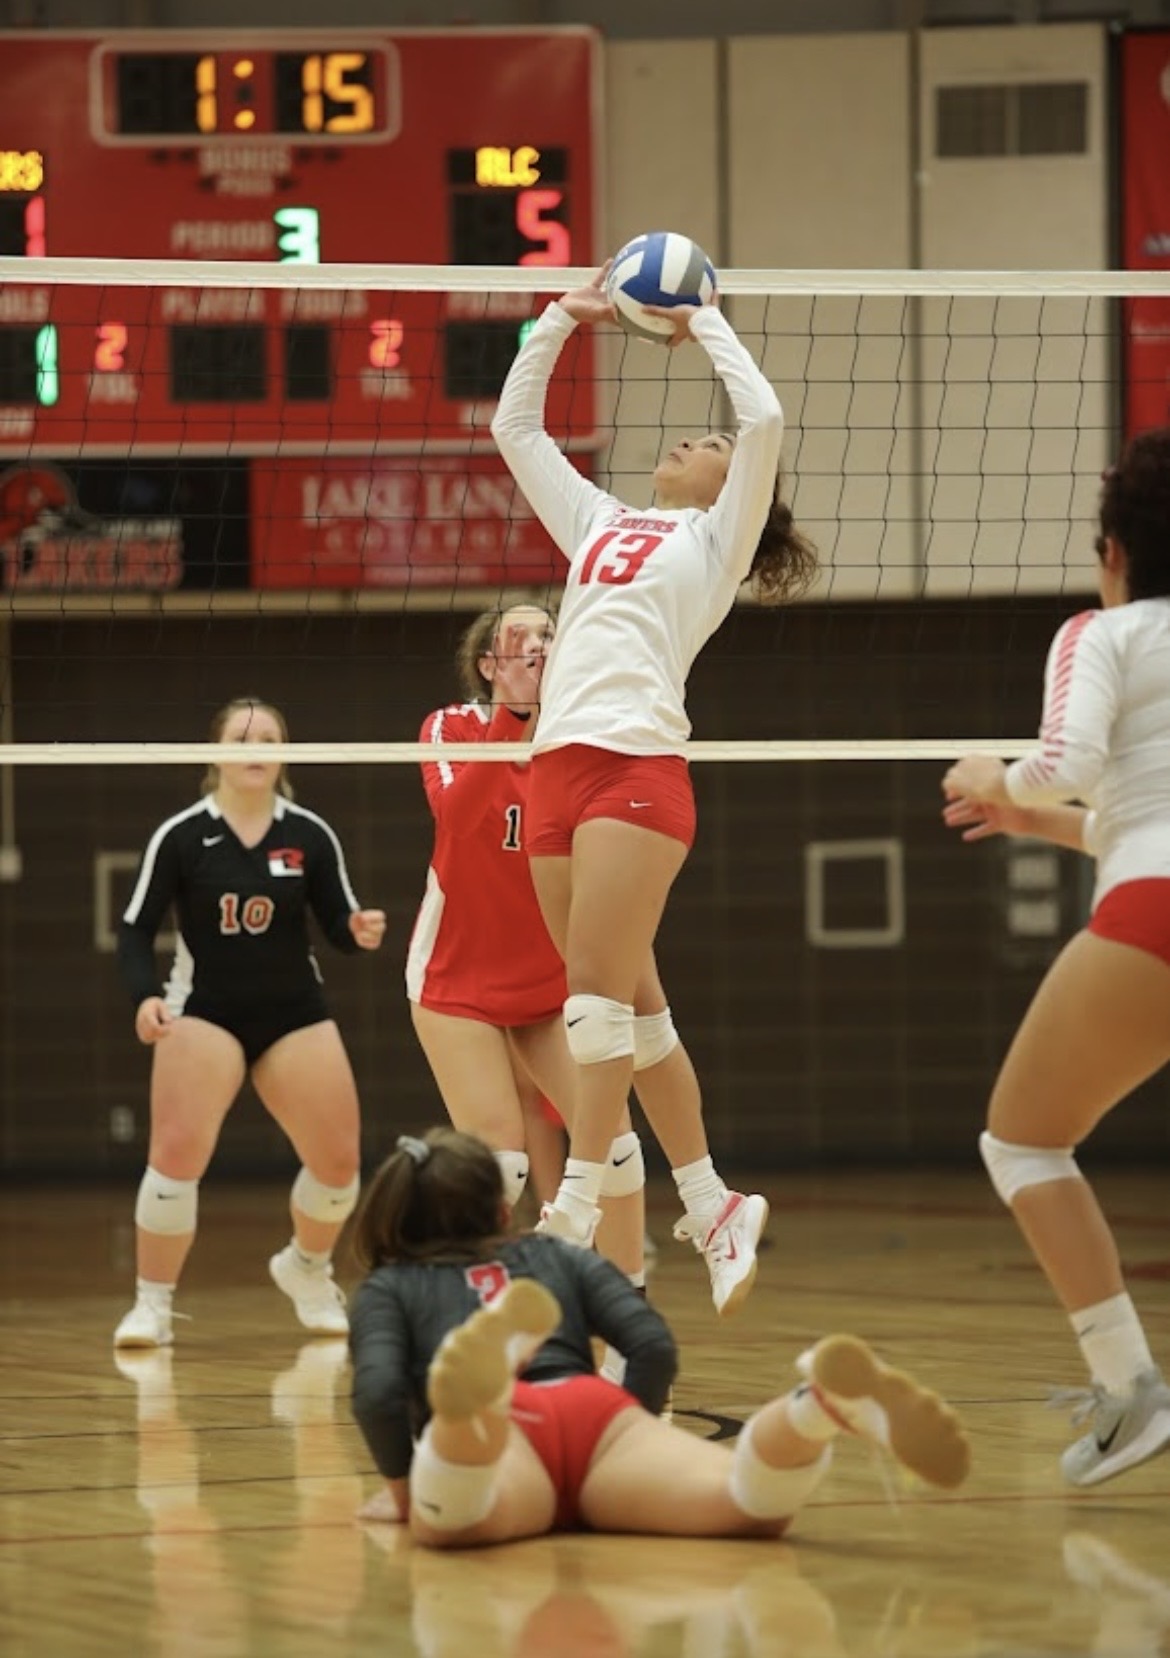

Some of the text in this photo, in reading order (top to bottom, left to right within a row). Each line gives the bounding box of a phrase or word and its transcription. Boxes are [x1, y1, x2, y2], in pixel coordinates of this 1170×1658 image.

[196, 53, 374, 133] 1:15
[0, 151, 43, 191] RS
[25, 196, 46, 257] 1
[273, 207, 320, 264] 3
[516, 189, 571, 267] 5
[36, 323, 58, 406] 1
[95, 320, 128, 371] 2
[369, 319, 403, 368] 2
[578, 530, 664, 586] 13
[502, 804, 521, 851] 1
[219, 892, 274, 934] 10
